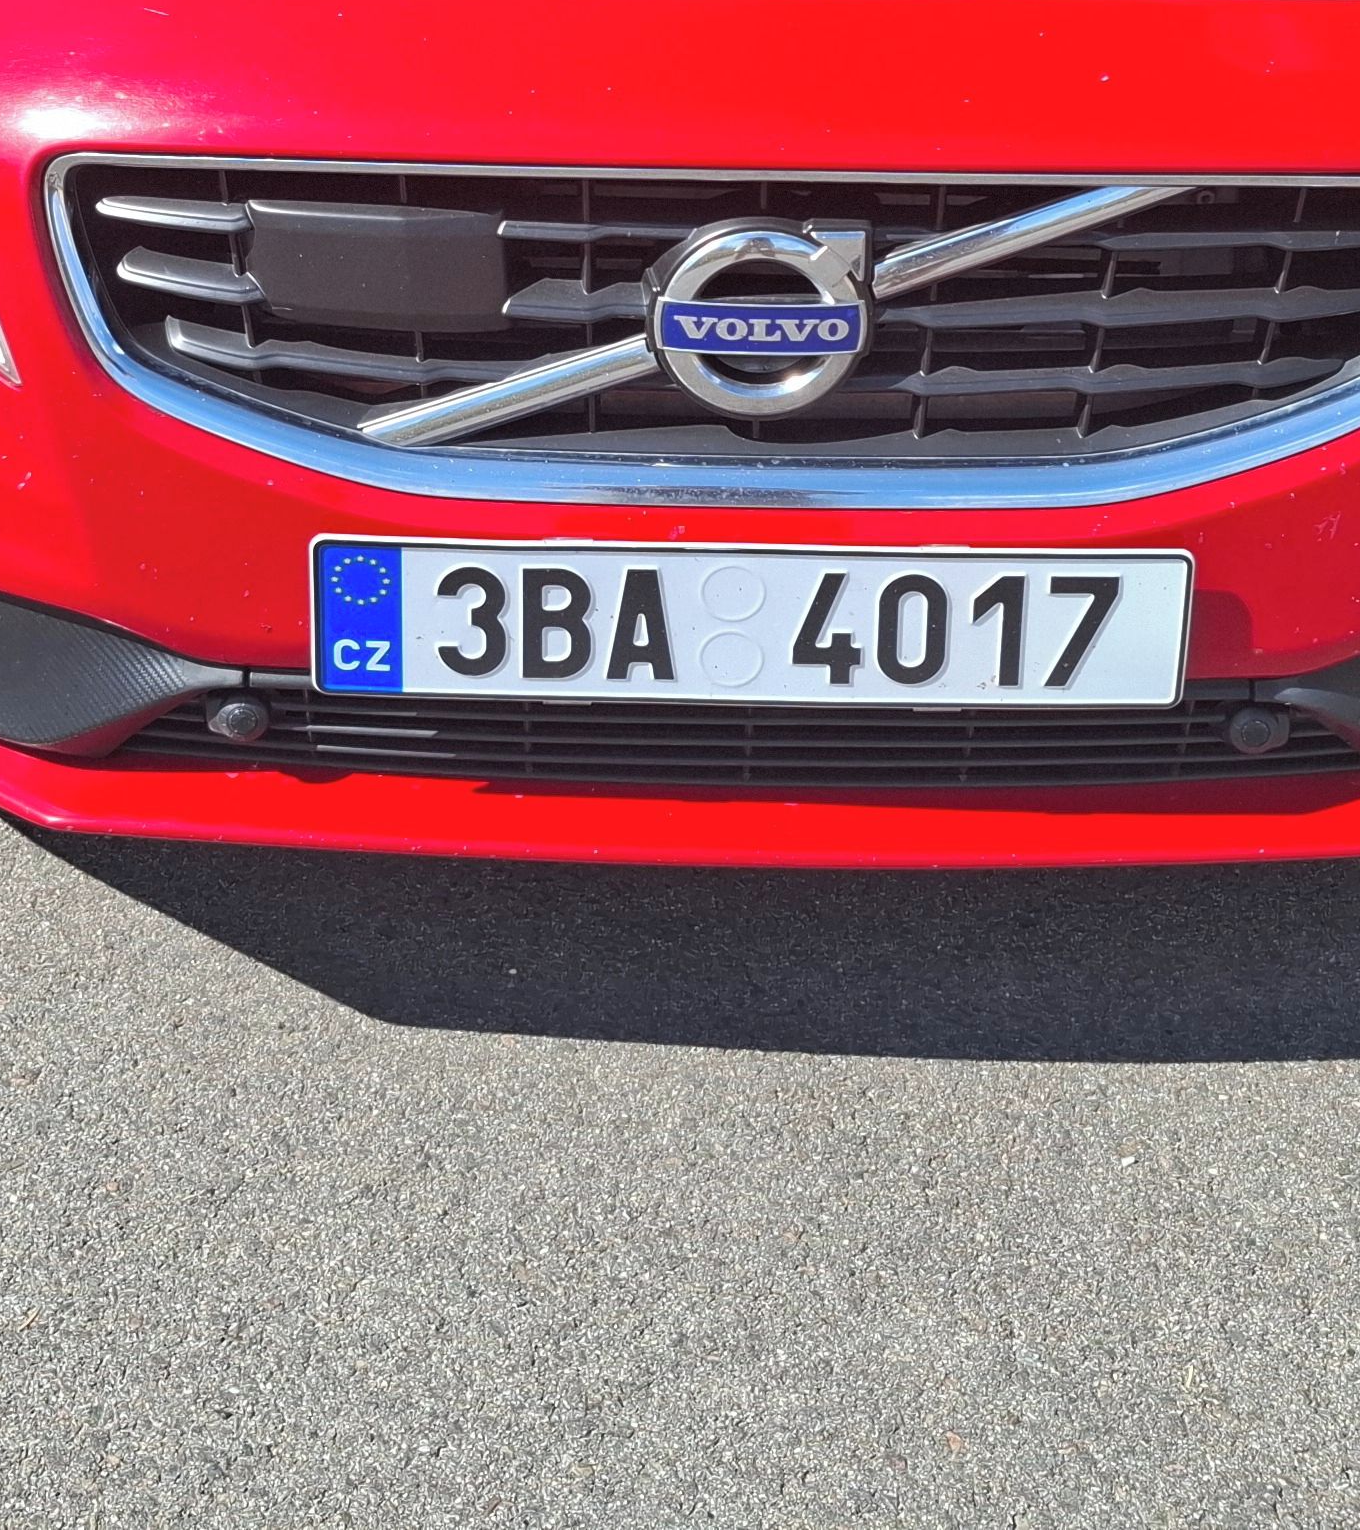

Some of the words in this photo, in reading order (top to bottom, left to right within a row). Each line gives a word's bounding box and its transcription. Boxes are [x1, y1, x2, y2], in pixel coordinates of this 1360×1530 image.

[673, 315, 850, 342] VOLVO
[436, 566, 675, 681] 3BA
[791, 571, 1122, 687] 4017
[332, 639, 391, 672] CZ
